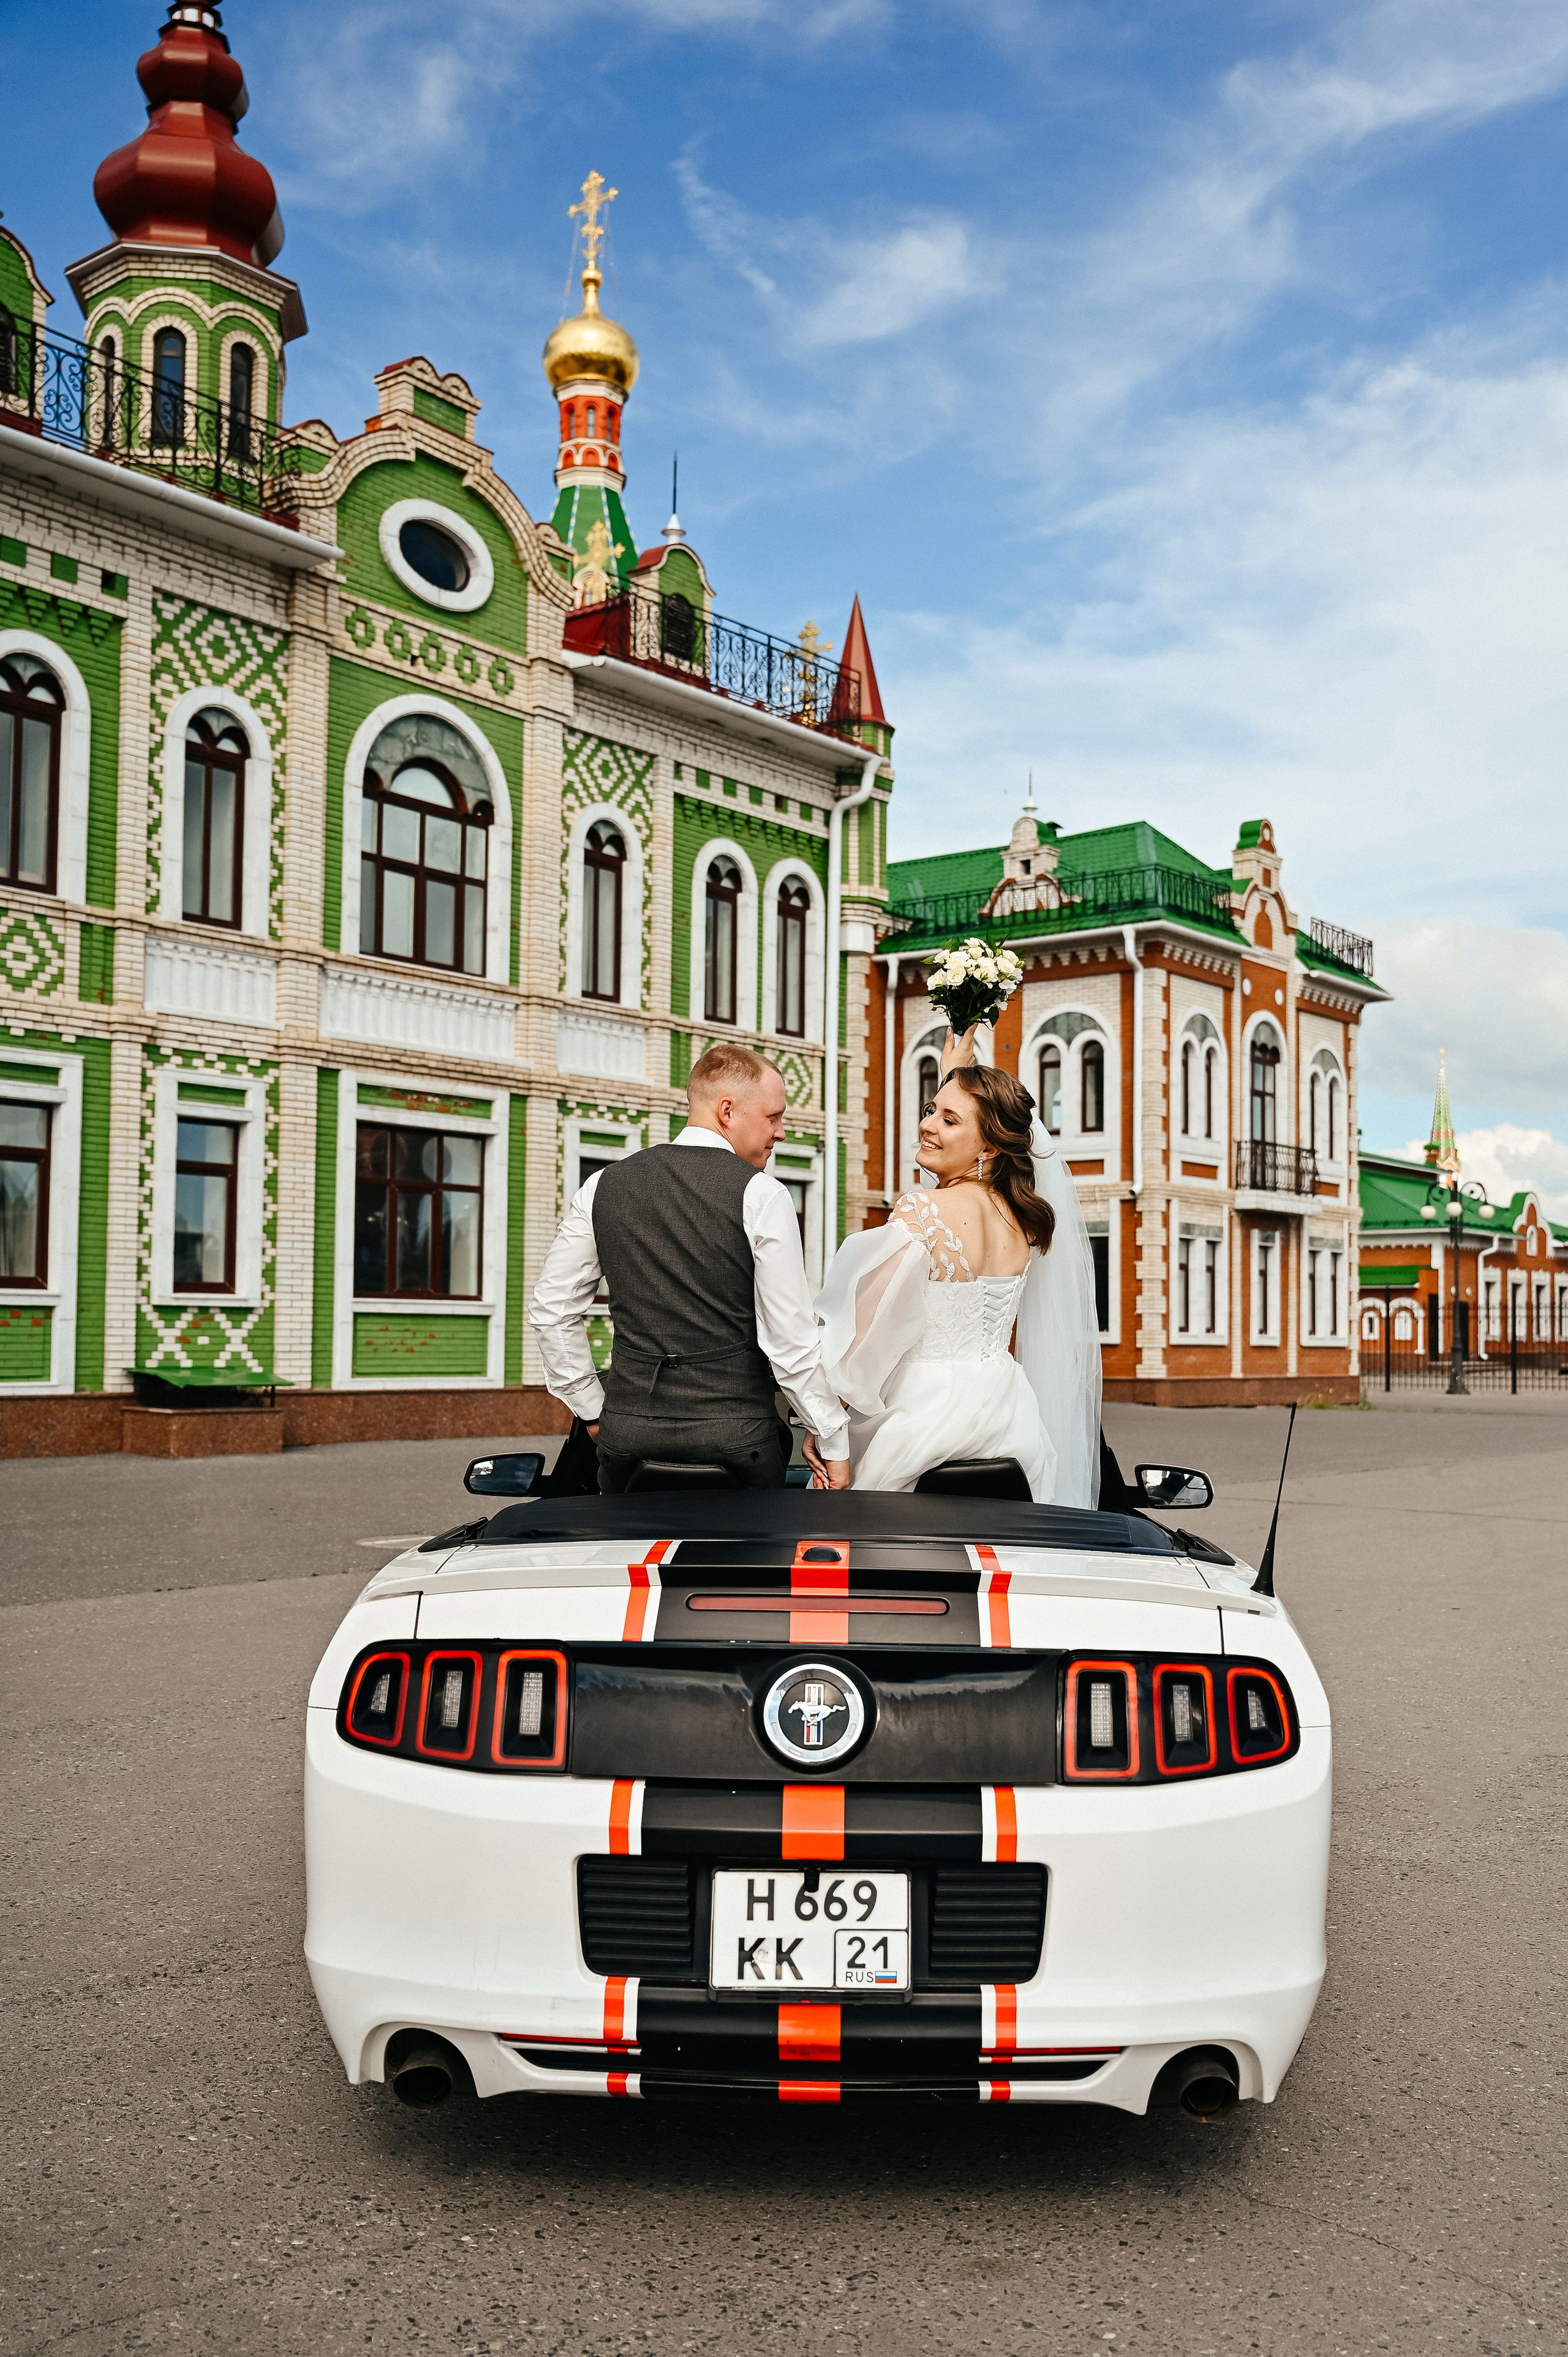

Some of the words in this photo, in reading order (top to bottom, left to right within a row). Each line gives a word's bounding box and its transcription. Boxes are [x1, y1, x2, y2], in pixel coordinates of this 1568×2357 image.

[794, 1879, 877, 1921] 669
[847, 1936, 888, 1969] 21
[845, 1971, 874, 1983] RUS
